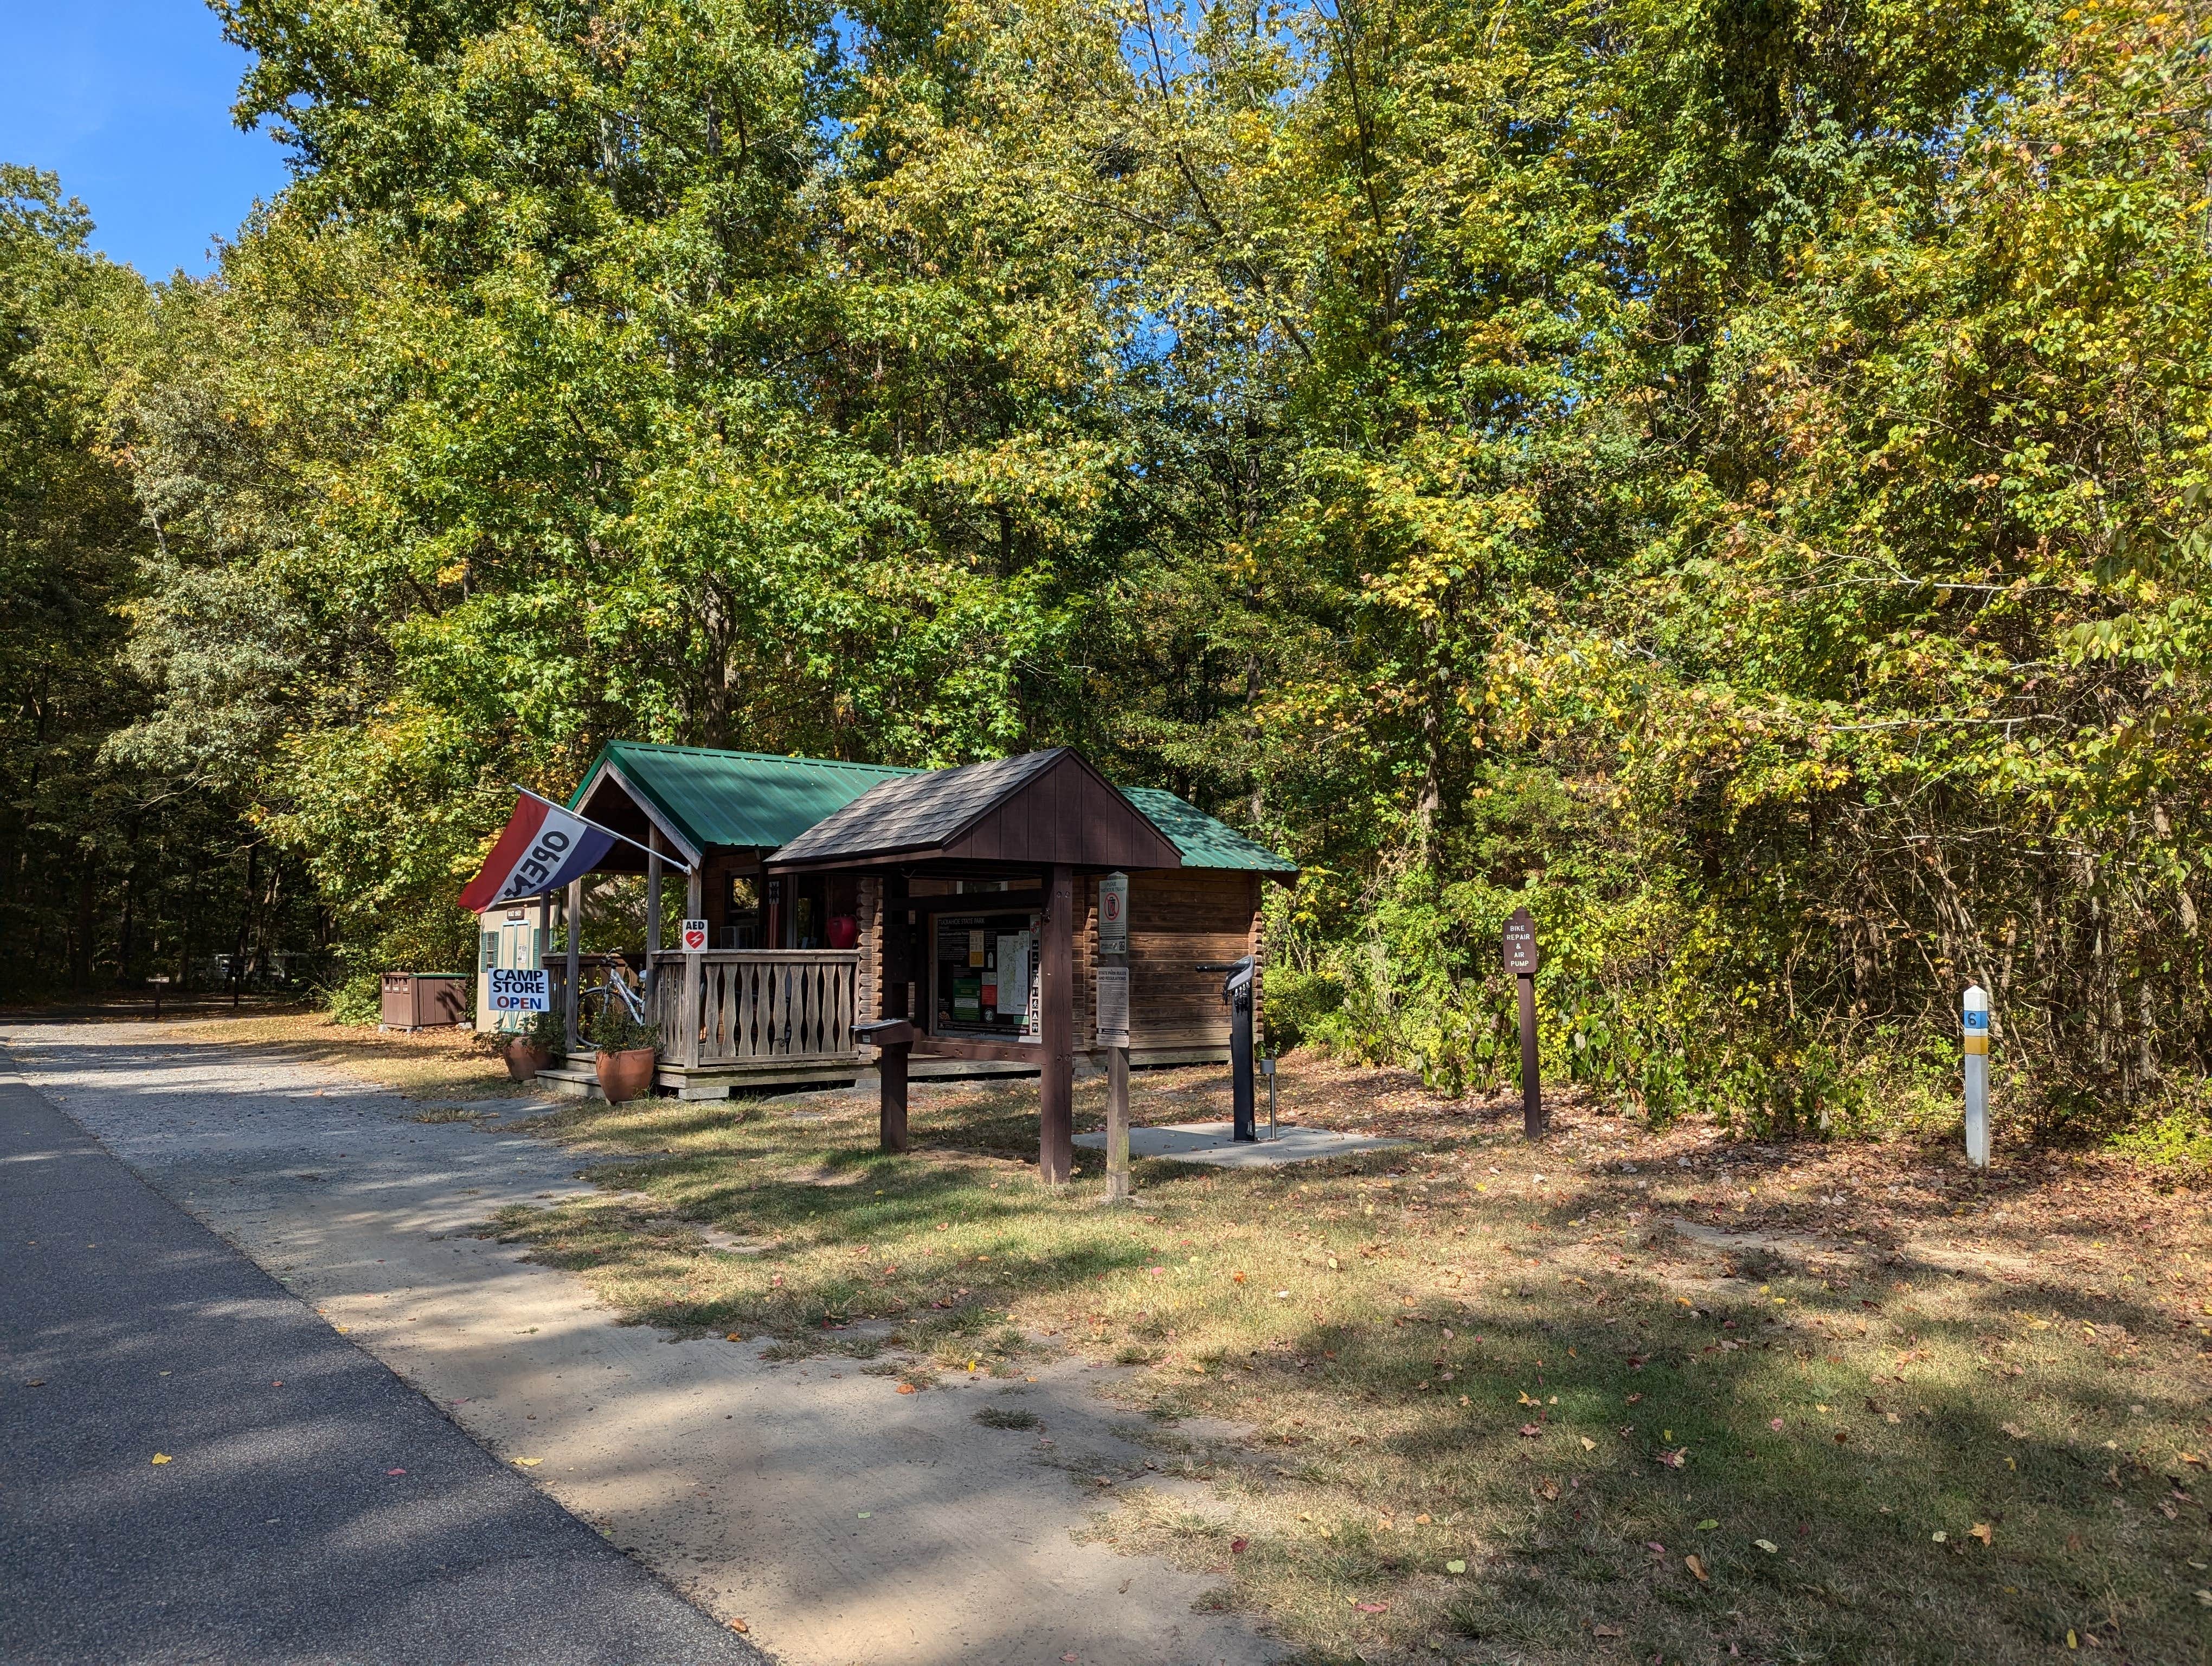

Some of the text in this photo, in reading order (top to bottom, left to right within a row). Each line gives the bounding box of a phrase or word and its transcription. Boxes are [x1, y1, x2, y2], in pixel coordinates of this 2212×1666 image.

[685, 921, 705, 930] AED
[493, 969, 543, 982] CAMP
[492, 981, 545, 994] STORE
[497, 996, 542, 1010] OPEN
[1967, 1013, 1977, 1025] 6
